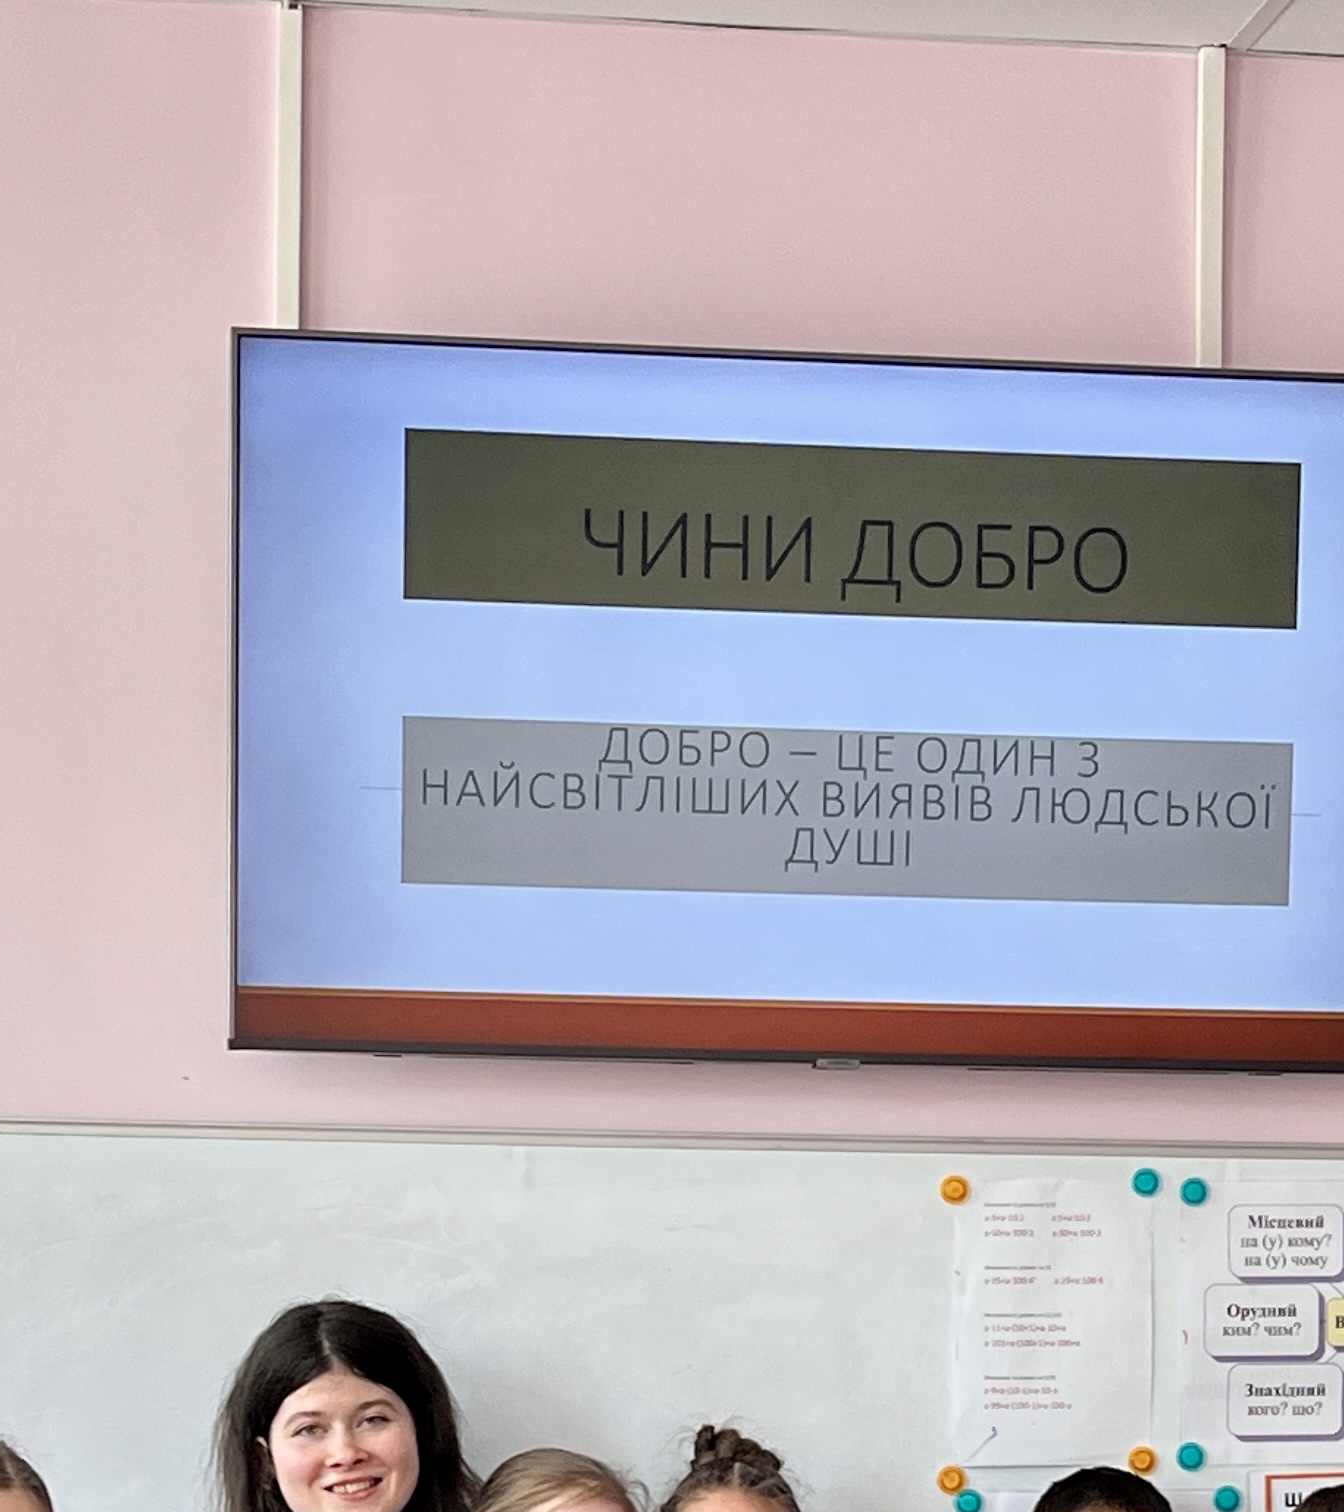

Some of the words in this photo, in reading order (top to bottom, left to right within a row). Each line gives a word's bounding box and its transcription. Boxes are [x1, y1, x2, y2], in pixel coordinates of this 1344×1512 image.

[584, 508, 813, 583] ЧИНИ
[841, 519, 1128, 603] ДОБРО
[599, 727, 770, 774] ДОБРО
[838, 734, 895, 781] ЦЕ
[916, 736, 1056, 784] ОДИН
[1077, 741, 1099, 778] З
[422, 761, 800, 817] НАЙСВІТЛІШИХ
[822, 781, 993, 823] ВИЯВІВ
[1011, 783, 1276, 835] ЛЮДСЬКОЇ
[785, 827, 911, 873] ДУШІ
[1247, 1215, 1324, 1230] Місцевий
[1240, 1238, 1258, 1248] на
[1262, 1234, 1283, 1250] (у)
[1287, 1233, 1332, 1250] кому?
[1244, 1256, 1262, 1266] на
[1265, 1253, 1287, 1269] (у)
[1291, 1256, 1328, 1269] чому
[1222, 1322, 1260, 1336] ким?
[1264, 1322, 1301, 1336] чим?
[1244, 1383, 1326, 1398] Знахідний
[1247, 1402, 1288, 1416] кого?
[1292, 1402, 1323, 1417] що?
